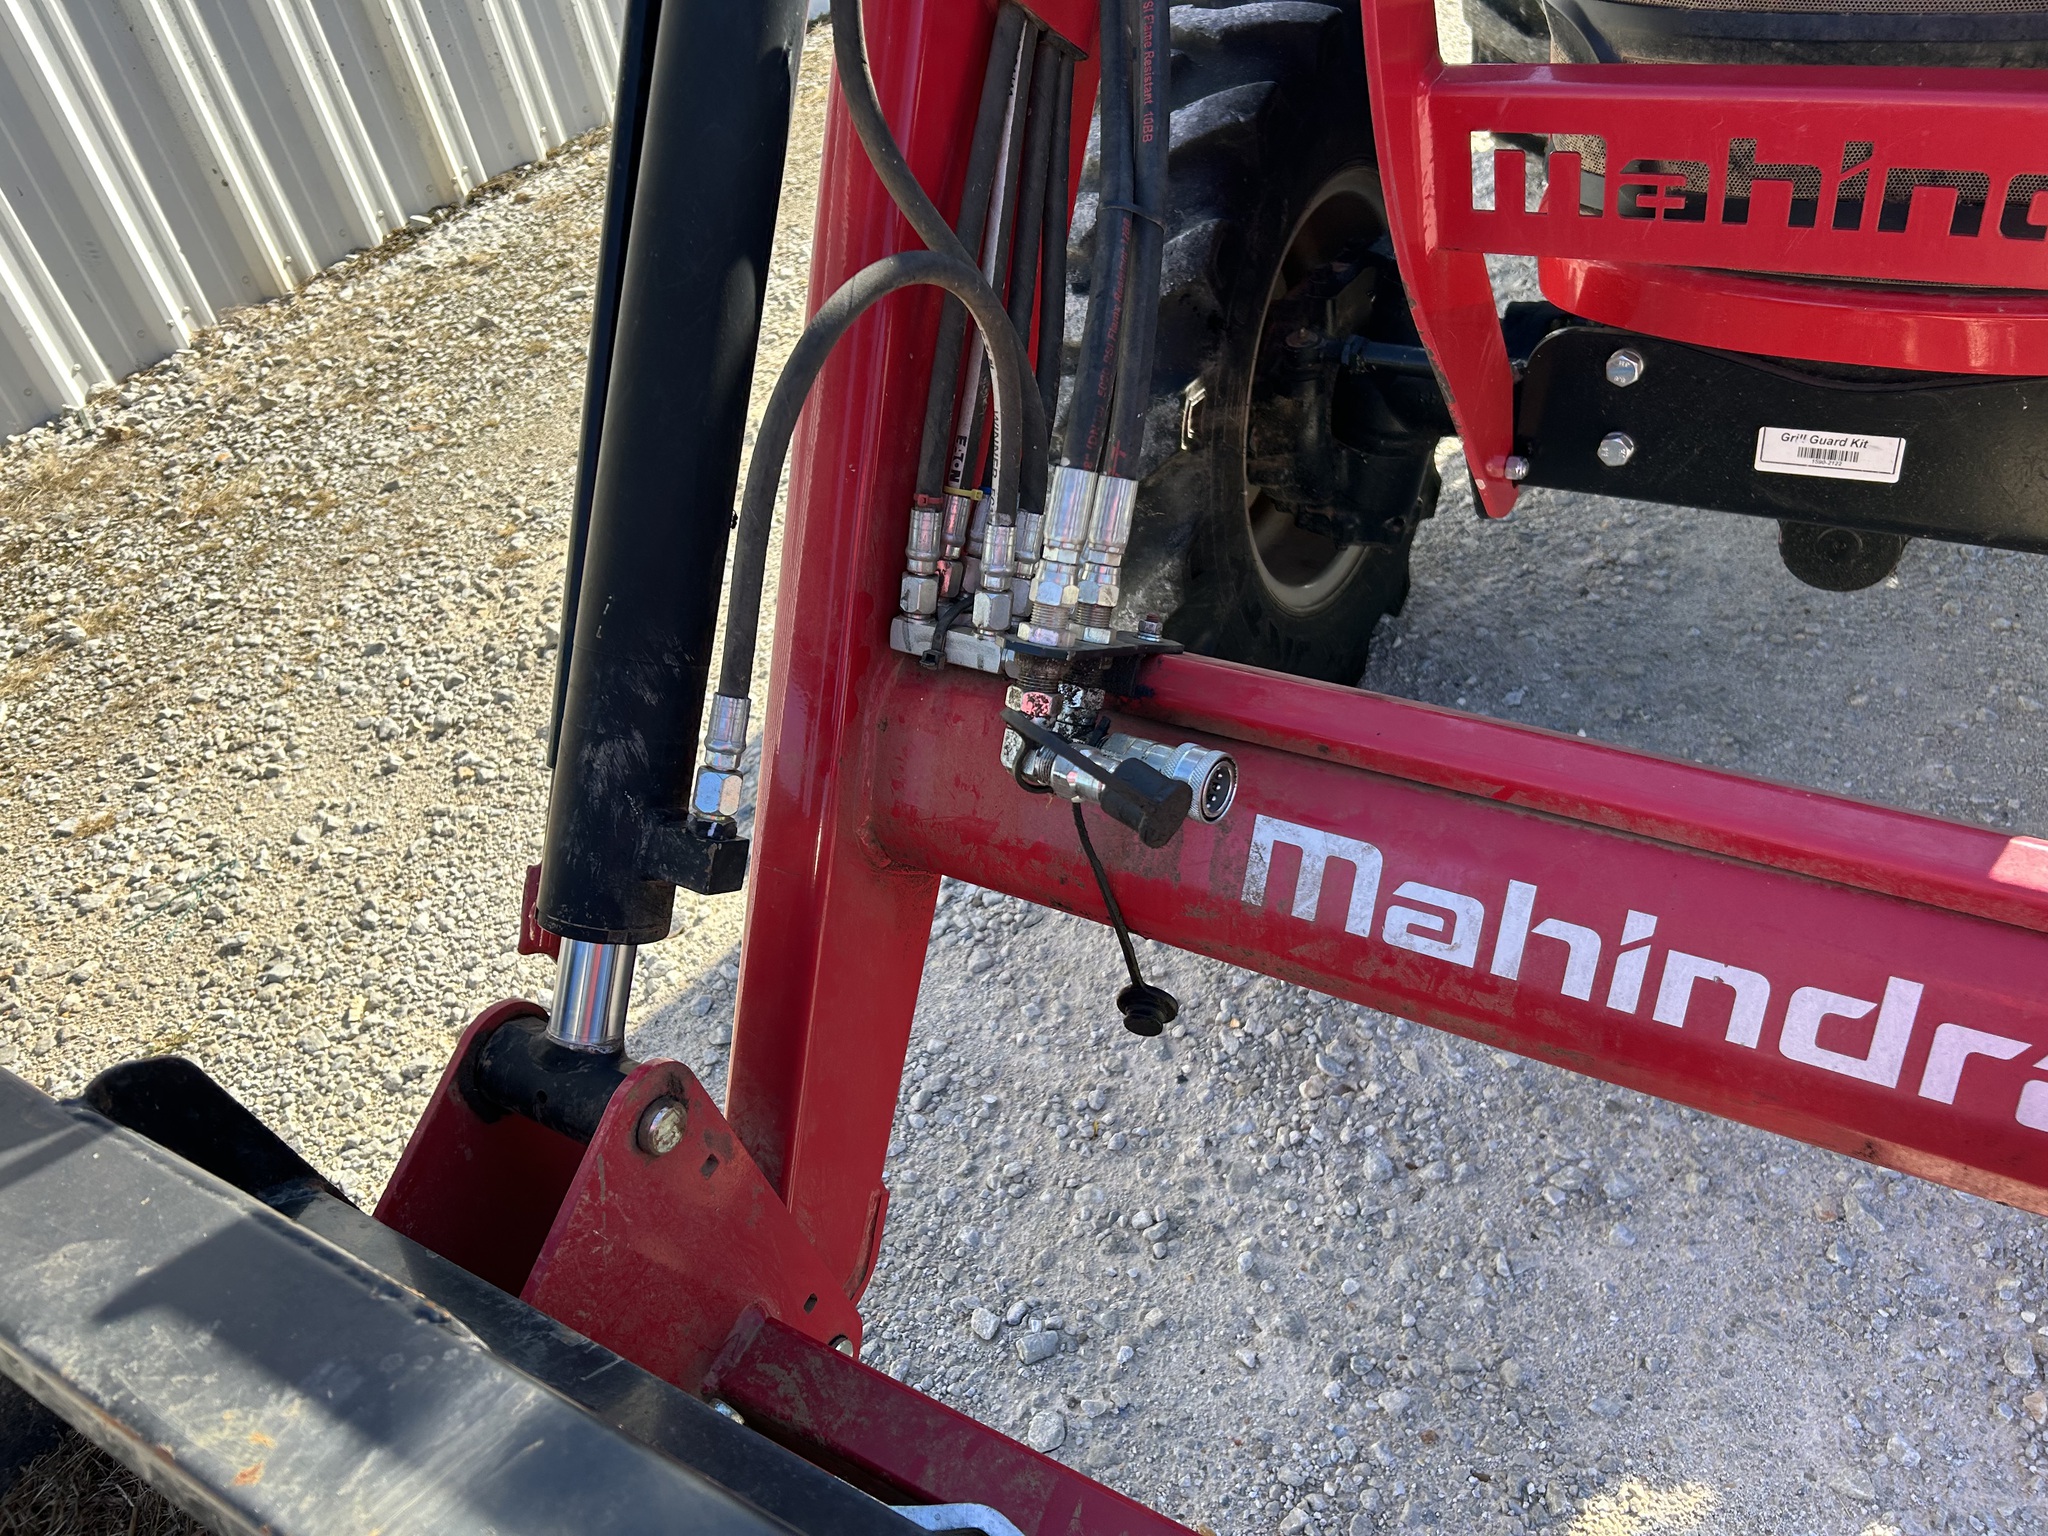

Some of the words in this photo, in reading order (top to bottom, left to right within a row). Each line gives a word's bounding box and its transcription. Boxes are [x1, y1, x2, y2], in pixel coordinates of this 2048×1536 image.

[1143, 14, 1155, 48] Flame
[1143, 50, 1155, 105] Resistant
[949, 435, 967, 483] EATON
[1809, 434, 1849, 447] Guard
[1850, 438, 1869, 449] Kit
